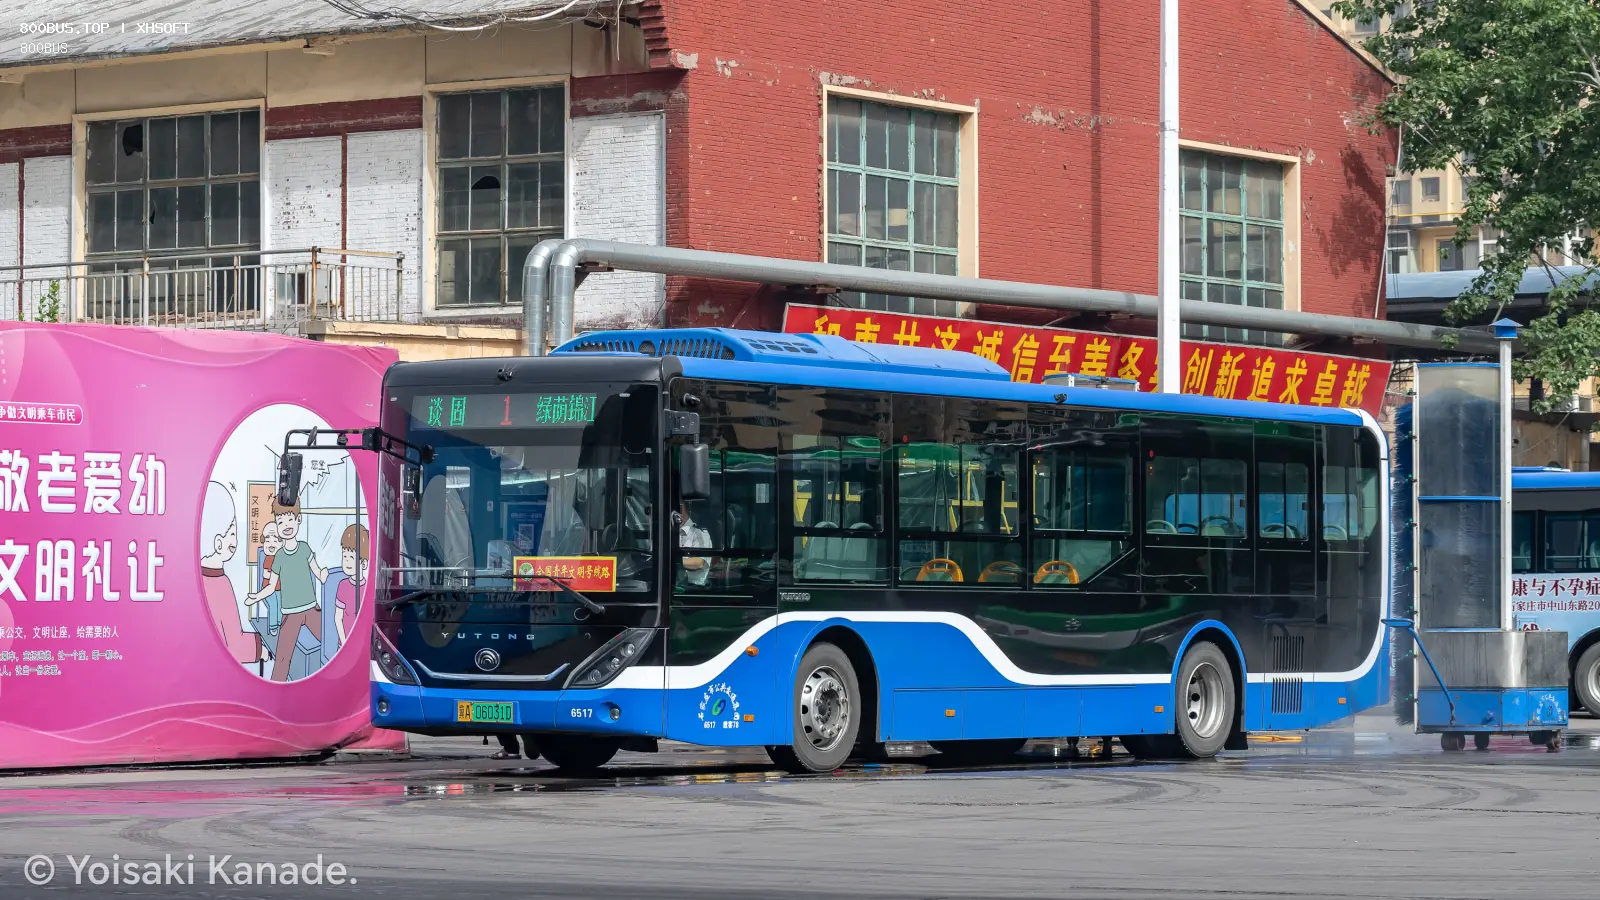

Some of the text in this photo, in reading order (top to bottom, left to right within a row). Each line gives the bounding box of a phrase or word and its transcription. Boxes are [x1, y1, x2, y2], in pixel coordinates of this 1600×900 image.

[813, 315, 1370, 409] 衷共济诚信至美务创新追求卓越
[0, 405, 76, 422] 争做文明乘车市民
[427, 396, 467, 427] 谈固
[500, 395, 513, 426] 1
[0, 449, 166, 515] 敬老爱幼
[0, 539, 164, 602] 文明礼让
[1512, 577, 1600, 597] 康与不孕症
[1512, 600, 1600, 612] 家庄市中山东路20
[441, 632, 535, 641] YUTONG
[570, 708, 593, 718] 6517
